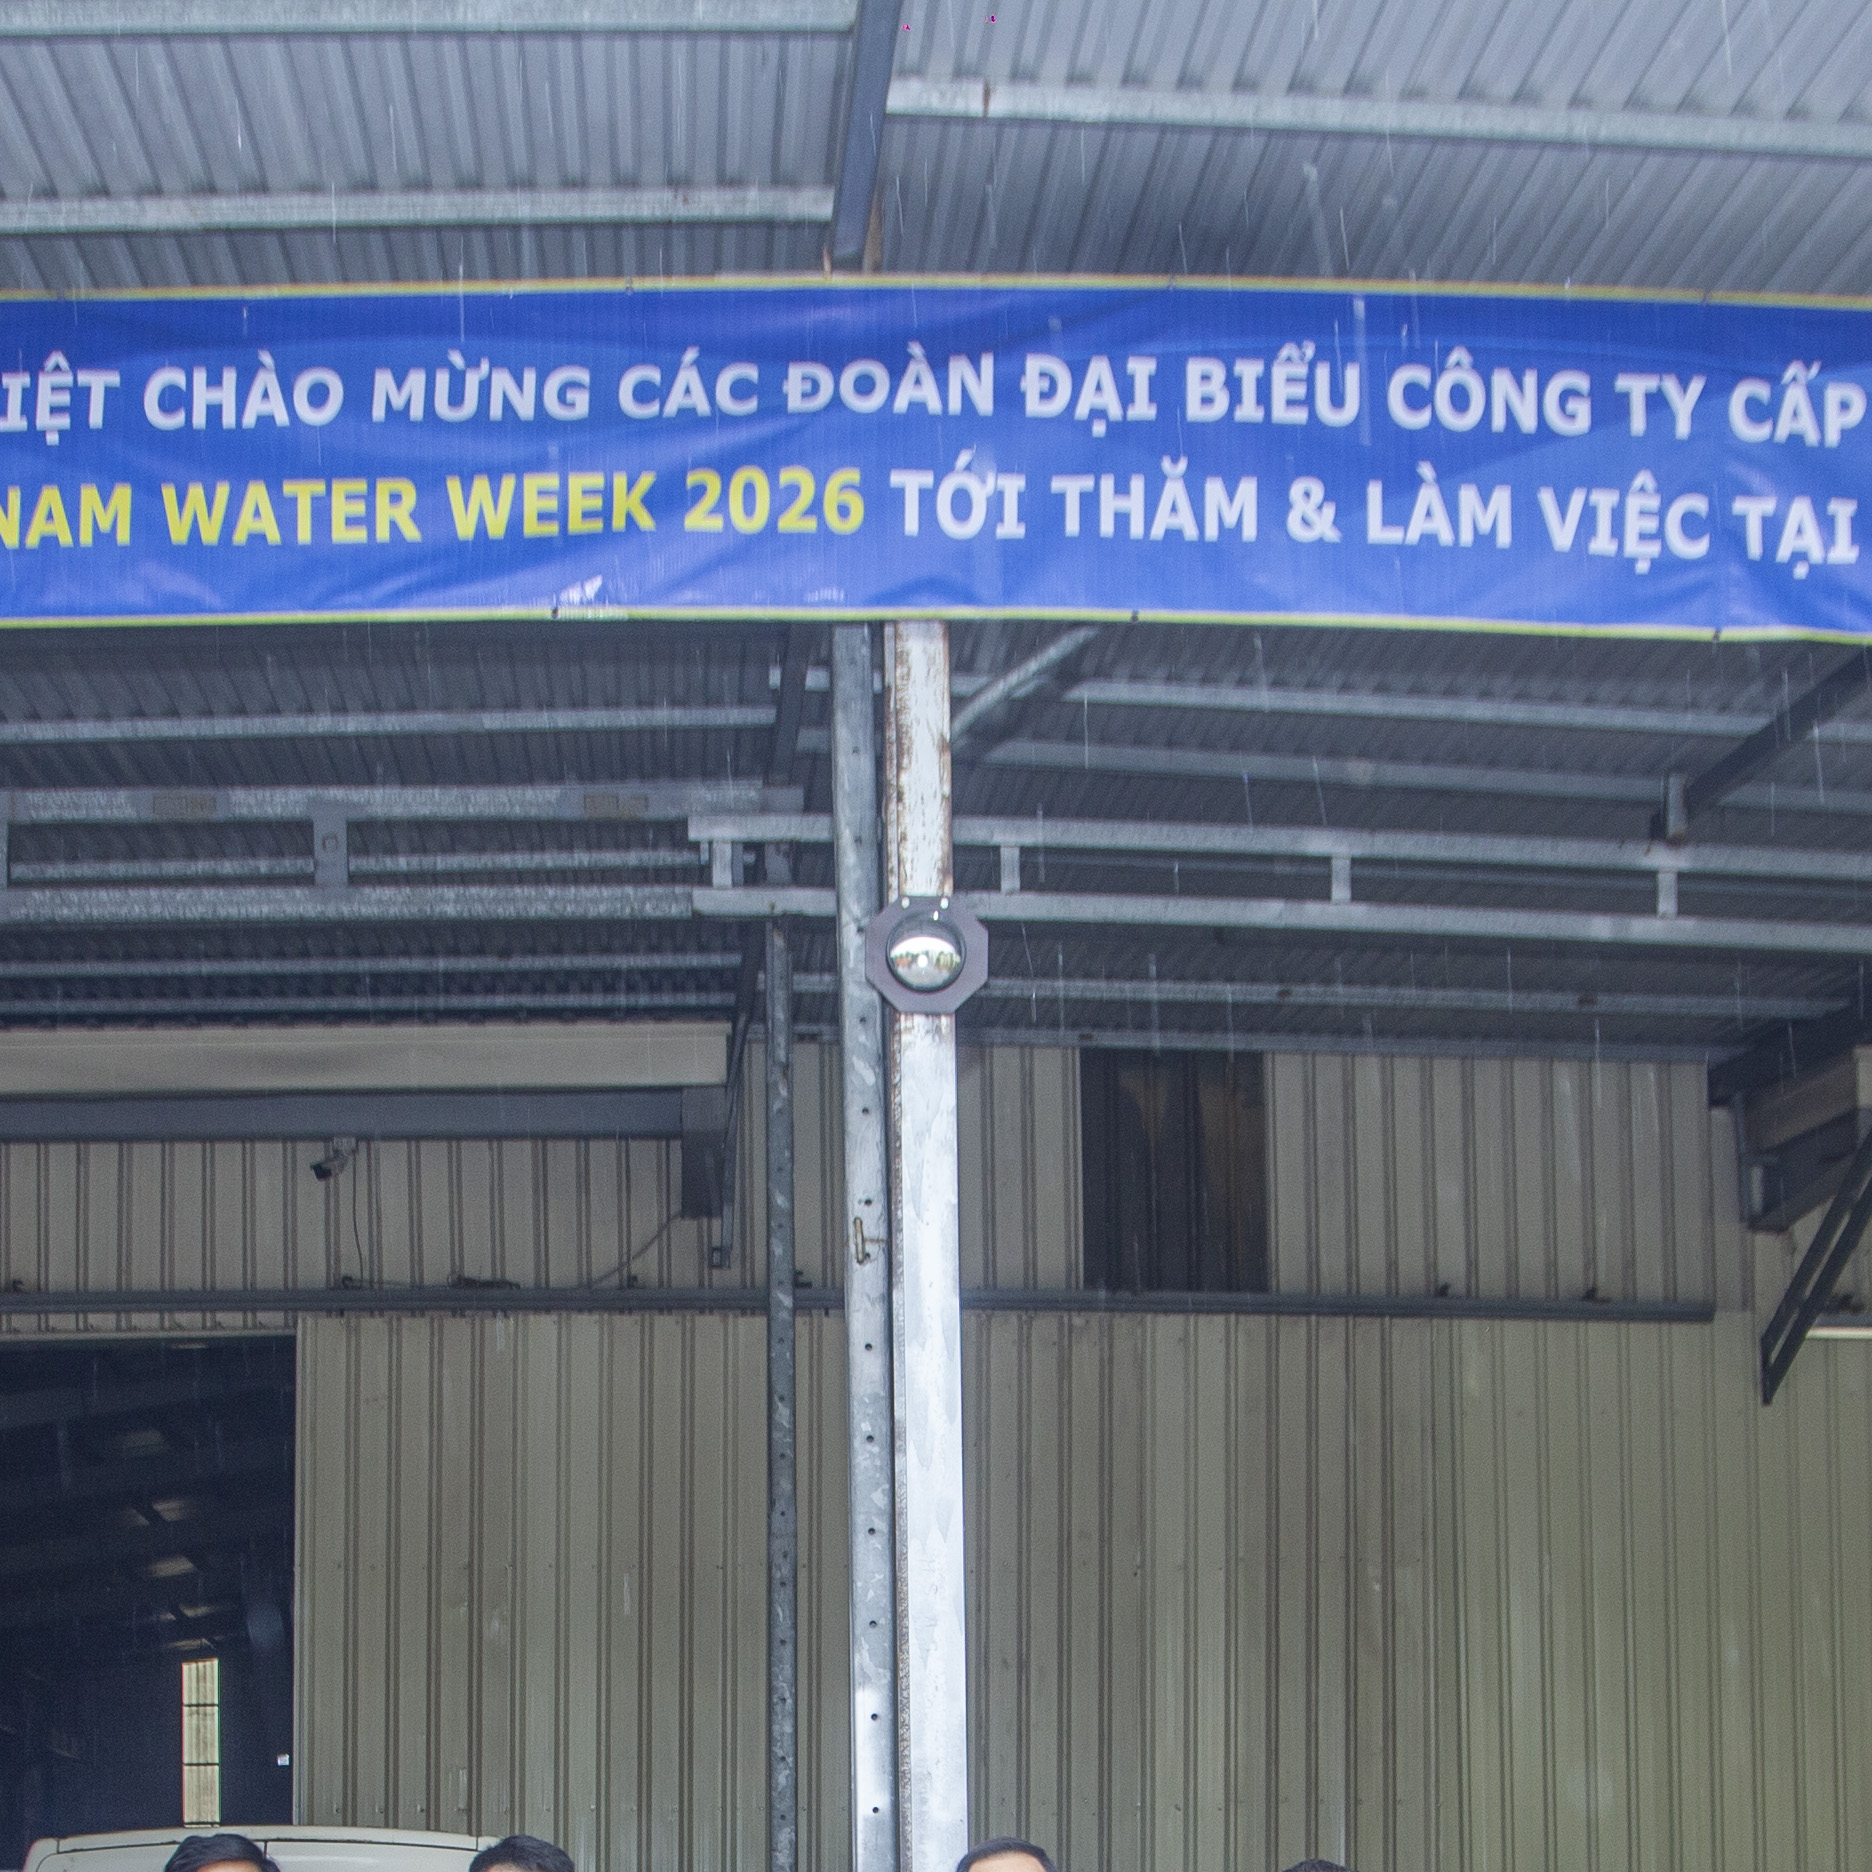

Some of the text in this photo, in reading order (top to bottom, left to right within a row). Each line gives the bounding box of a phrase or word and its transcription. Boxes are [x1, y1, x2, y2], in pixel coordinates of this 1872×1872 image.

[143, 349, 344, 430] CHÀO
[371, 349, 591, 422] MỪNG
[618, 347, 759, 417] CÁC
[782, 341, 995, 416] ĐOÀN
[1021, 355, 1158, 437] ĐẠI
[1185, 341, 1361, 426] BIỂU
[1388, 347, 1592, 437] CÔNG
[1614, 373, 1707, 440] TY
[1728, 360, 1867, 448] CẤP
[161, 478, 422, 547] WATER
[446, 471, 657, 540] WEEK
[684, 466, 866, 535] 2026
[890, 450, 1027, 540] TỚI
[1052, 455, 1258, 542] THĂM
[1286, 476, 1341, 544] &
[1367, 461, 1512, 549] LÀM
[1538, 470, 1711, 575] VIỆC
[1731, 496, 1860, 580] TẠI
